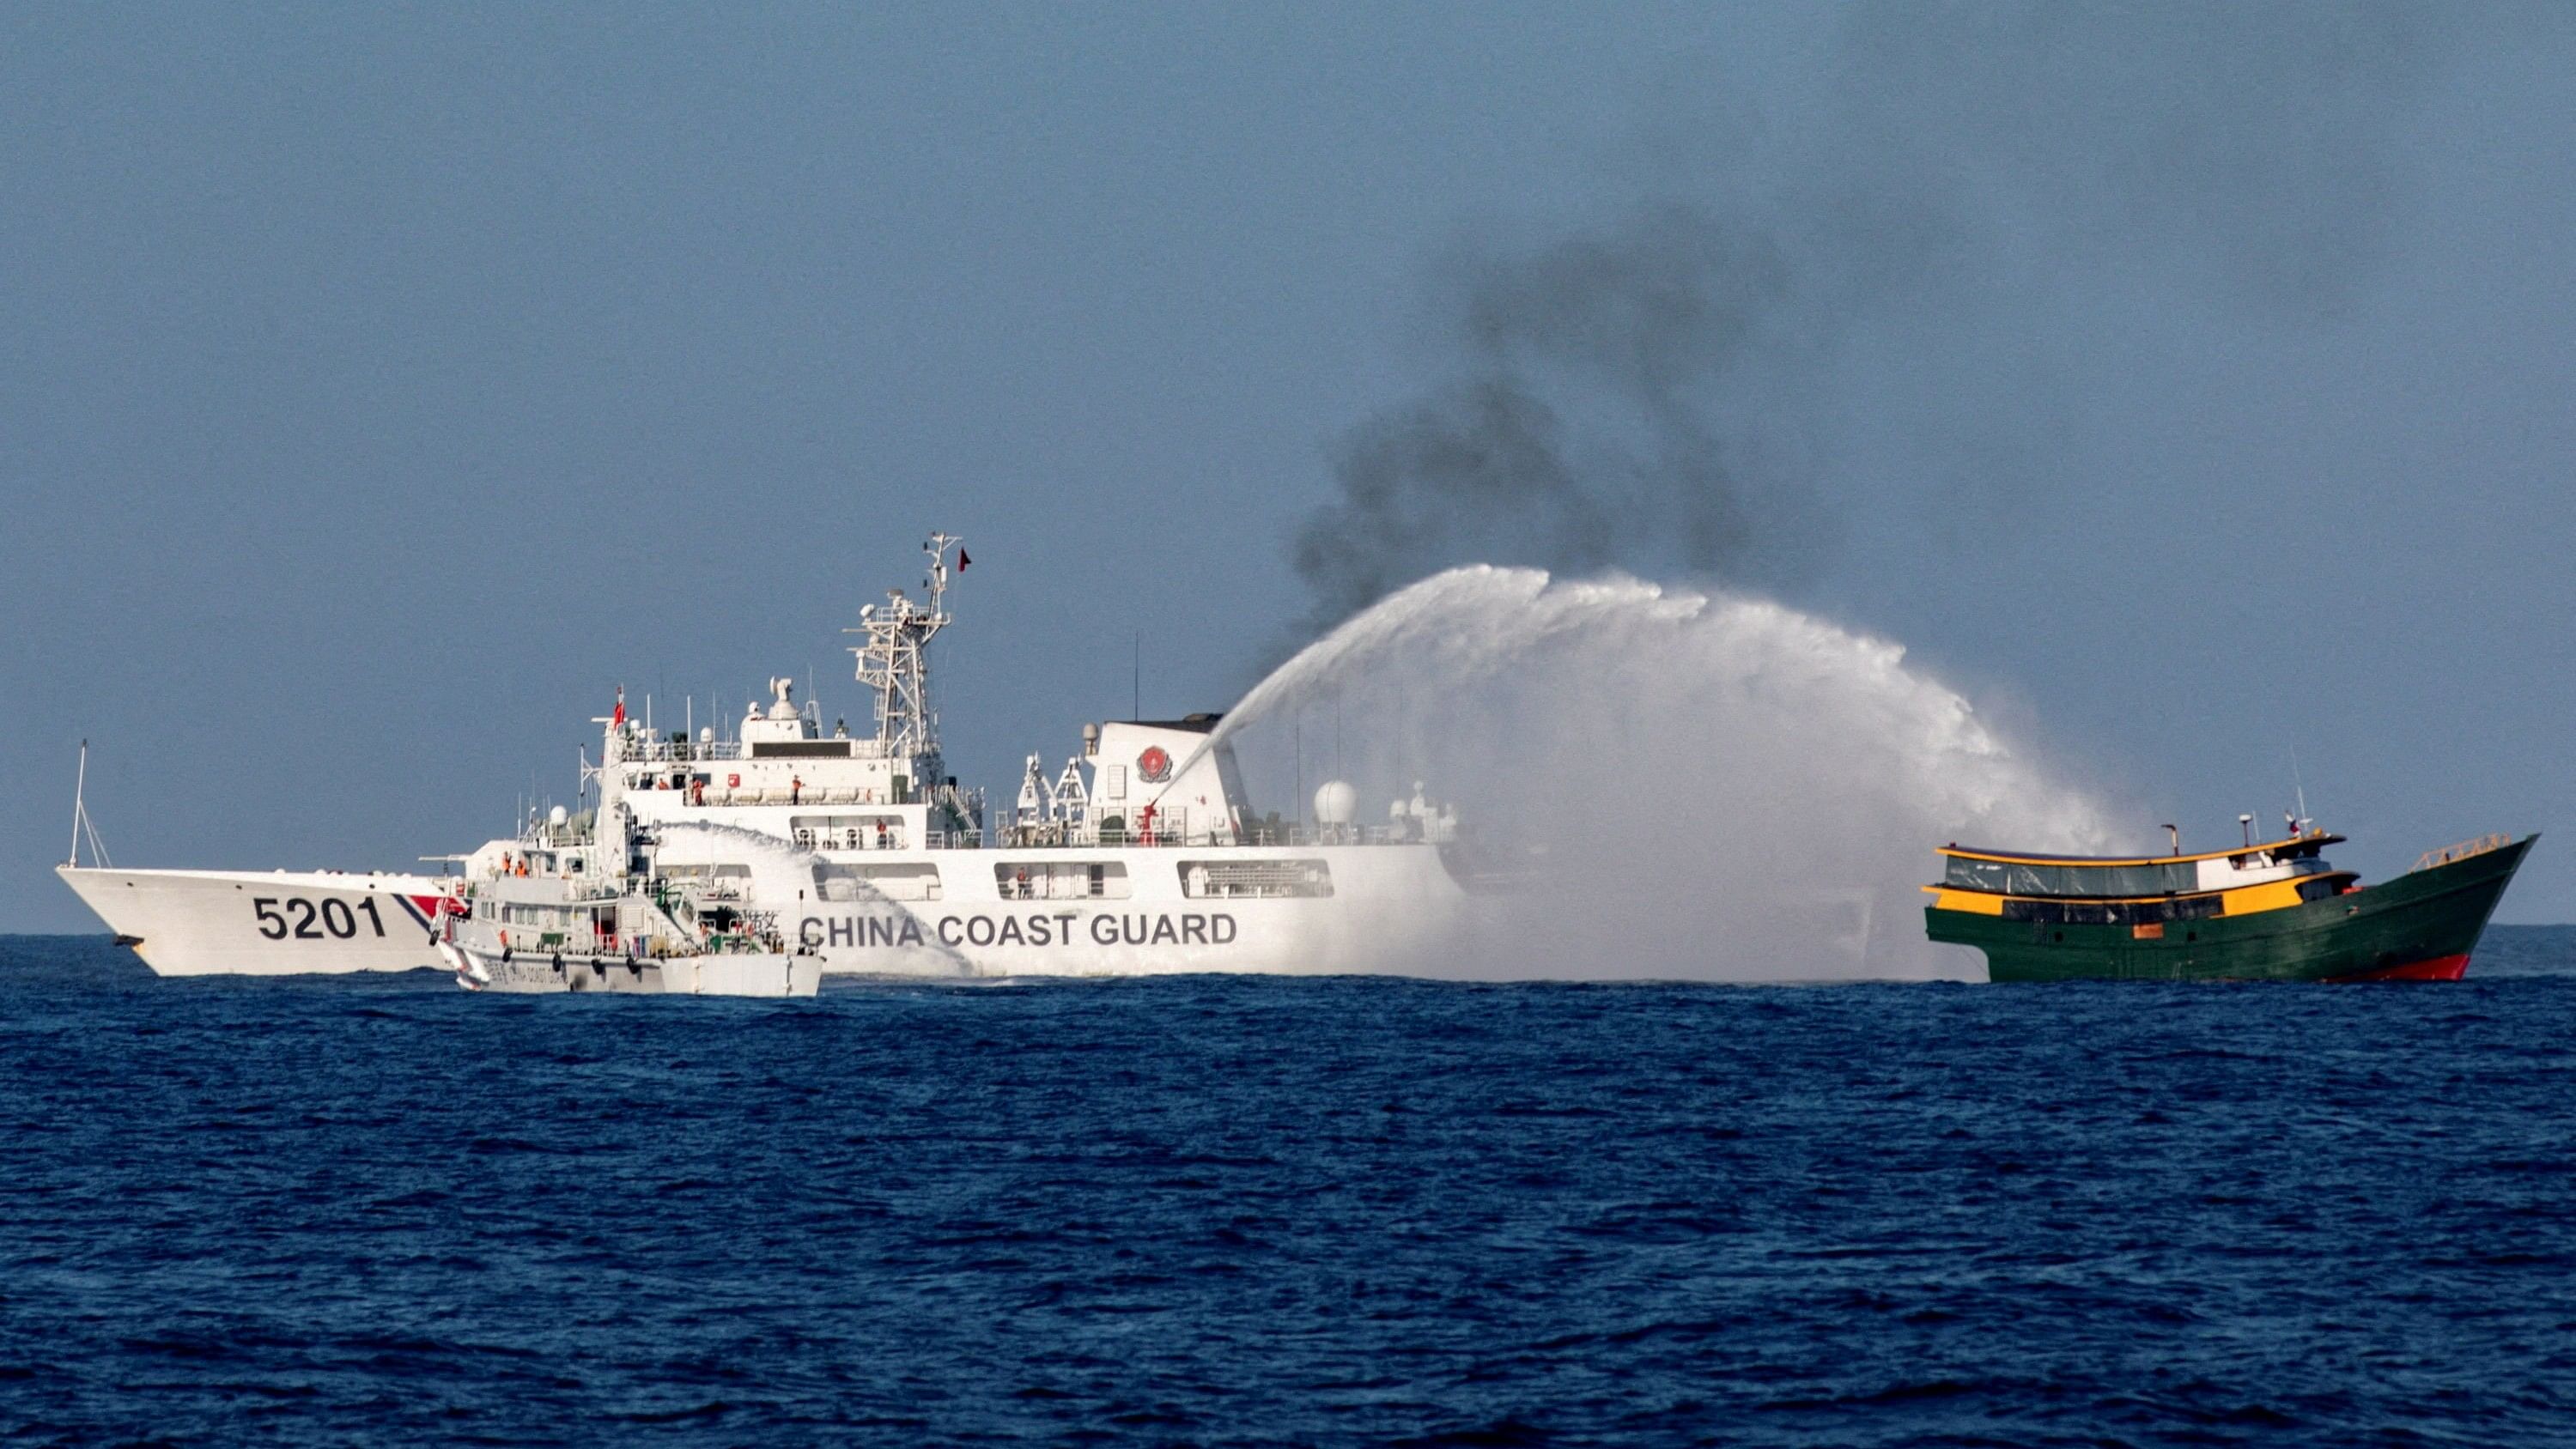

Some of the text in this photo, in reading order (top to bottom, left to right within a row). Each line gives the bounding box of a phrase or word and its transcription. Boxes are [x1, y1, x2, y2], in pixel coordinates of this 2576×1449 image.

[253, 896, 386, 940] 5201
[800, 916, 925, 947] CHINA
[938, 915, 1077, 946] COAST
[1091, 914, 1236, 945] GUARD
